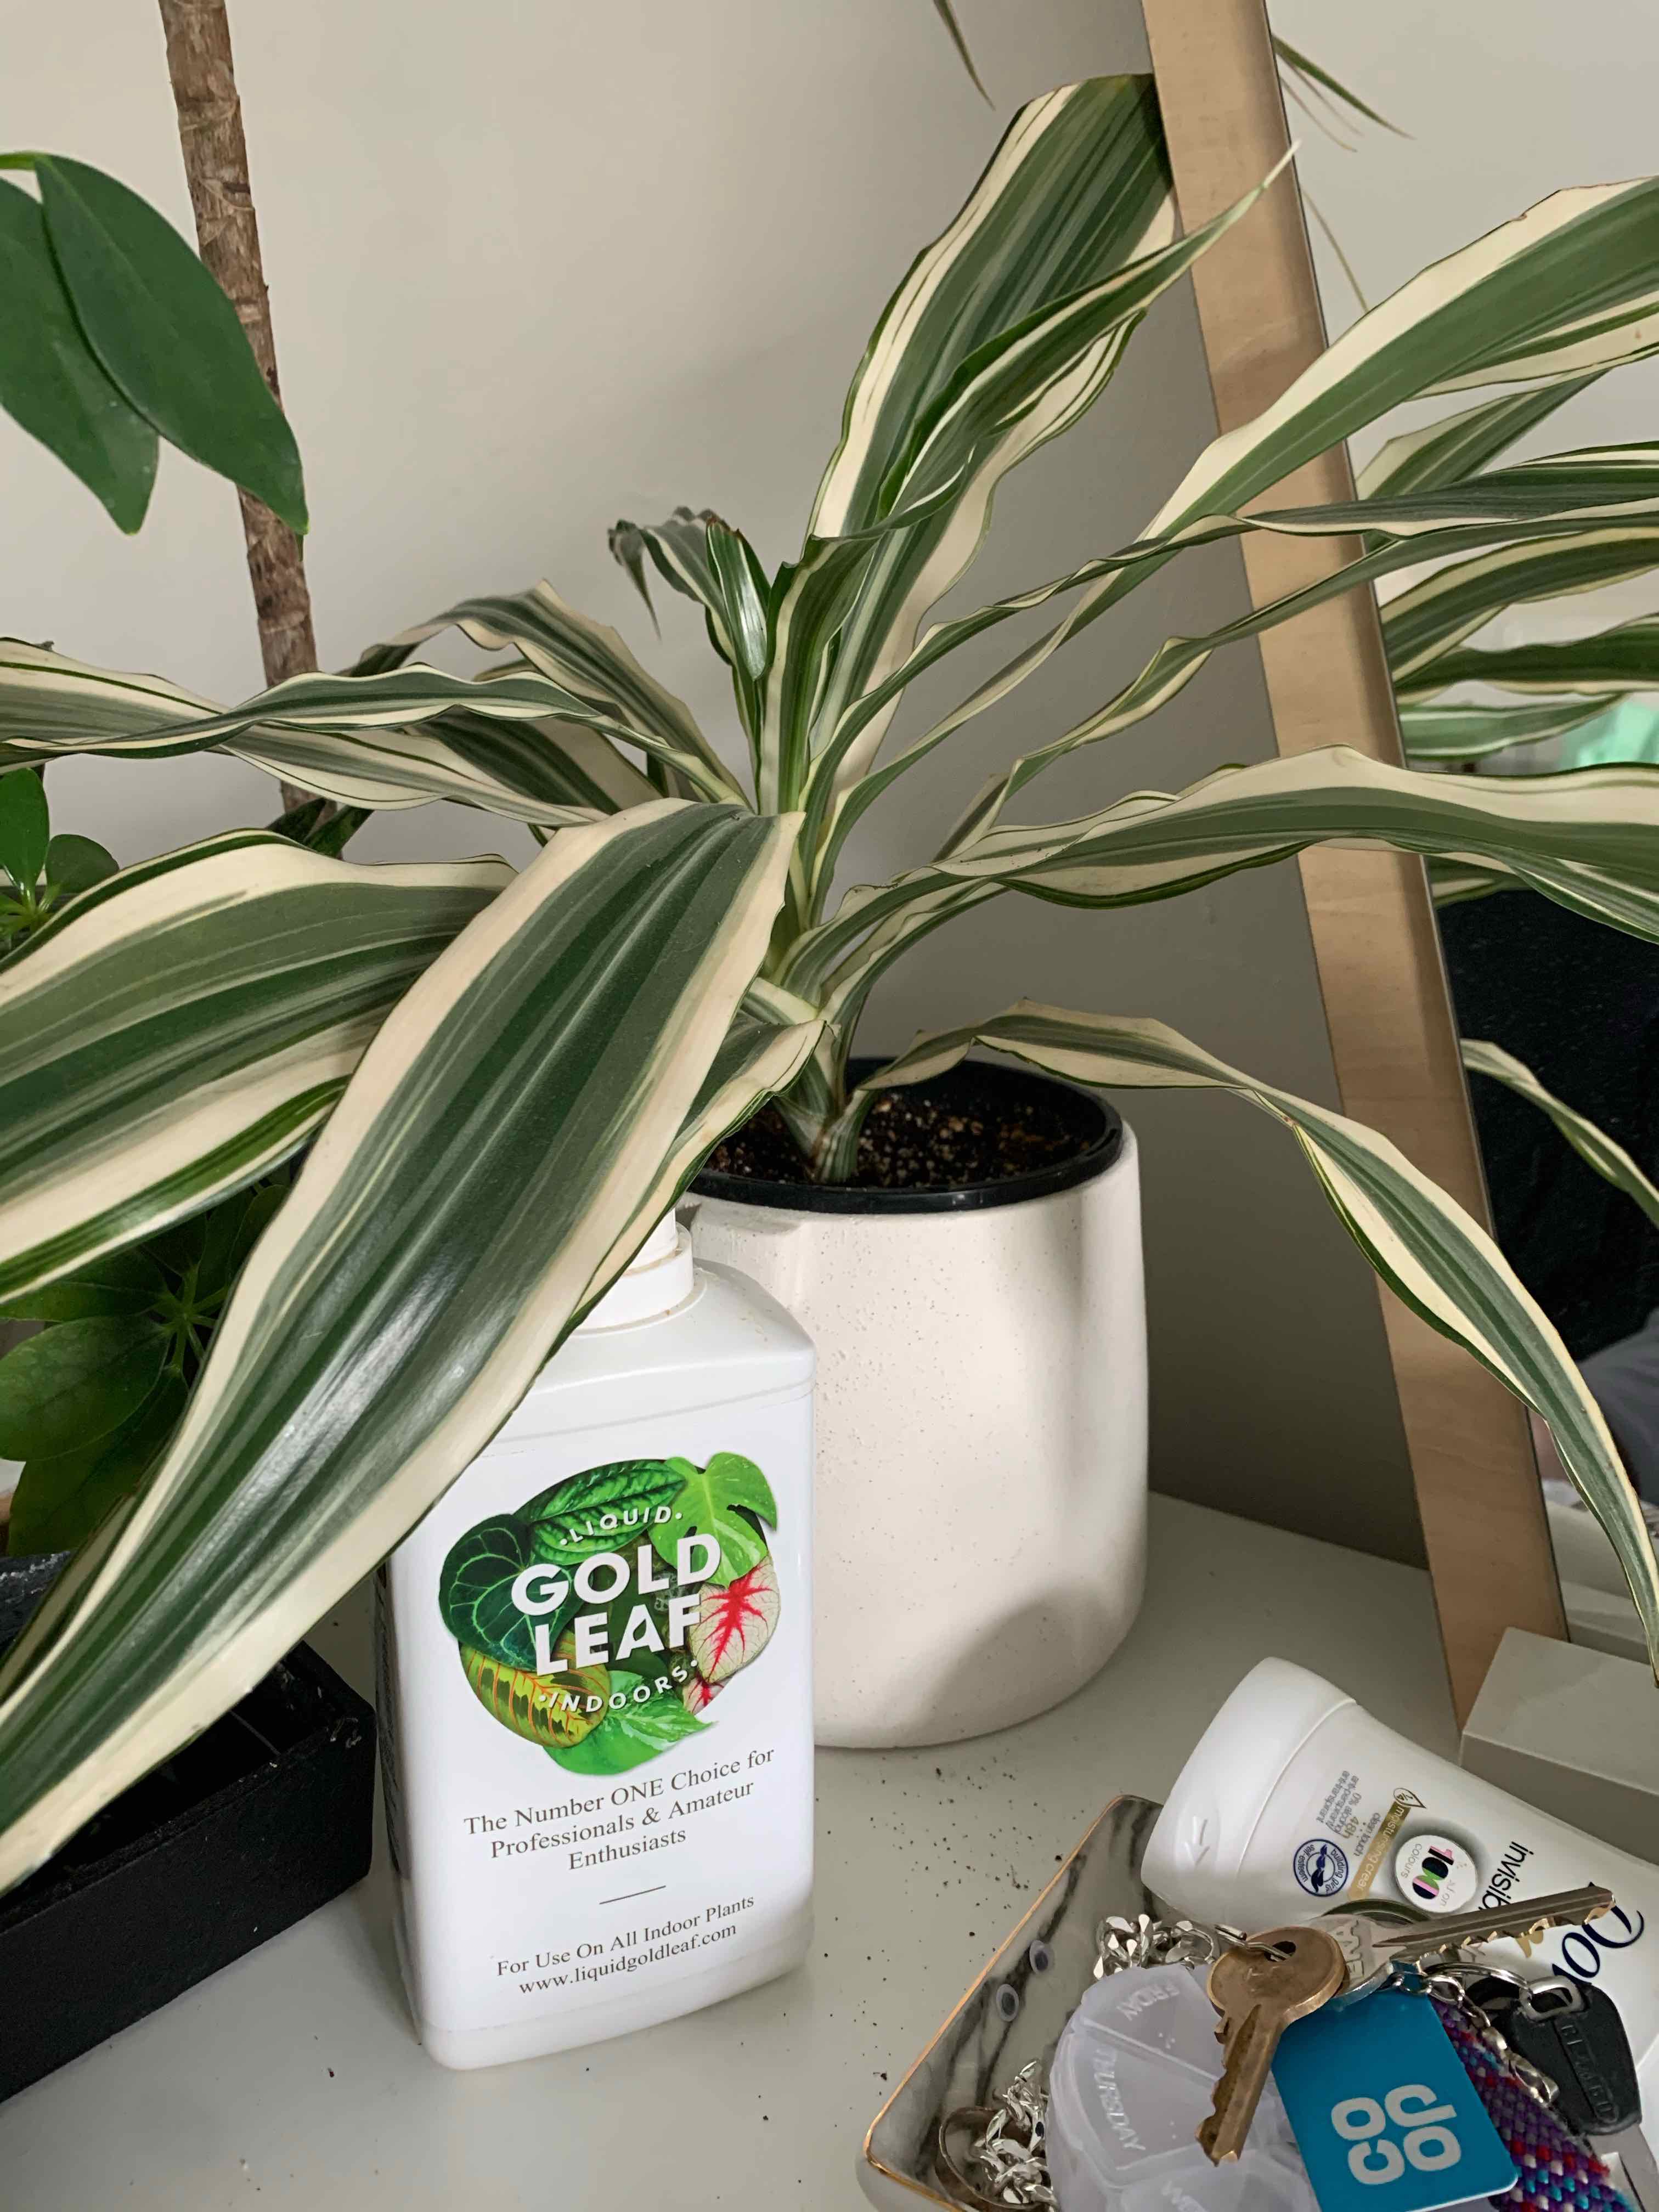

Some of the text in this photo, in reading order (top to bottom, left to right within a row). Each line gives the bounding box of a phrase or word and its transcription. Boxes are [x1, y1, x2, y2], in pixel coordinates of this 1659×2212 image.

[570, 1506, 673, 1543] LIQUID
[511, 1533, 721, 1616] GOLD
[535, 1594, 702, 1676] LEAF
[548, 1667, 689, 1712] INDOORS
[464, 1747, 775, 1835] The Number ONE Choice for
[491, 1780, 754, 1859] Professionals & Amateur
[568, 1829, 686, 1871] Enthusiasts
[1331, 1848, 1344, 1878] building
[1401, 1843, 1423, 1878] colours
[1413, 1844, 1457, 1899] 100
[1477, 1841, 1534, 1912] invisib
[496, 1895, 755, 1976] For Use On All Indoor Plants
[519, 1922, 737, 1994] www.liquidgoldleaf.com
